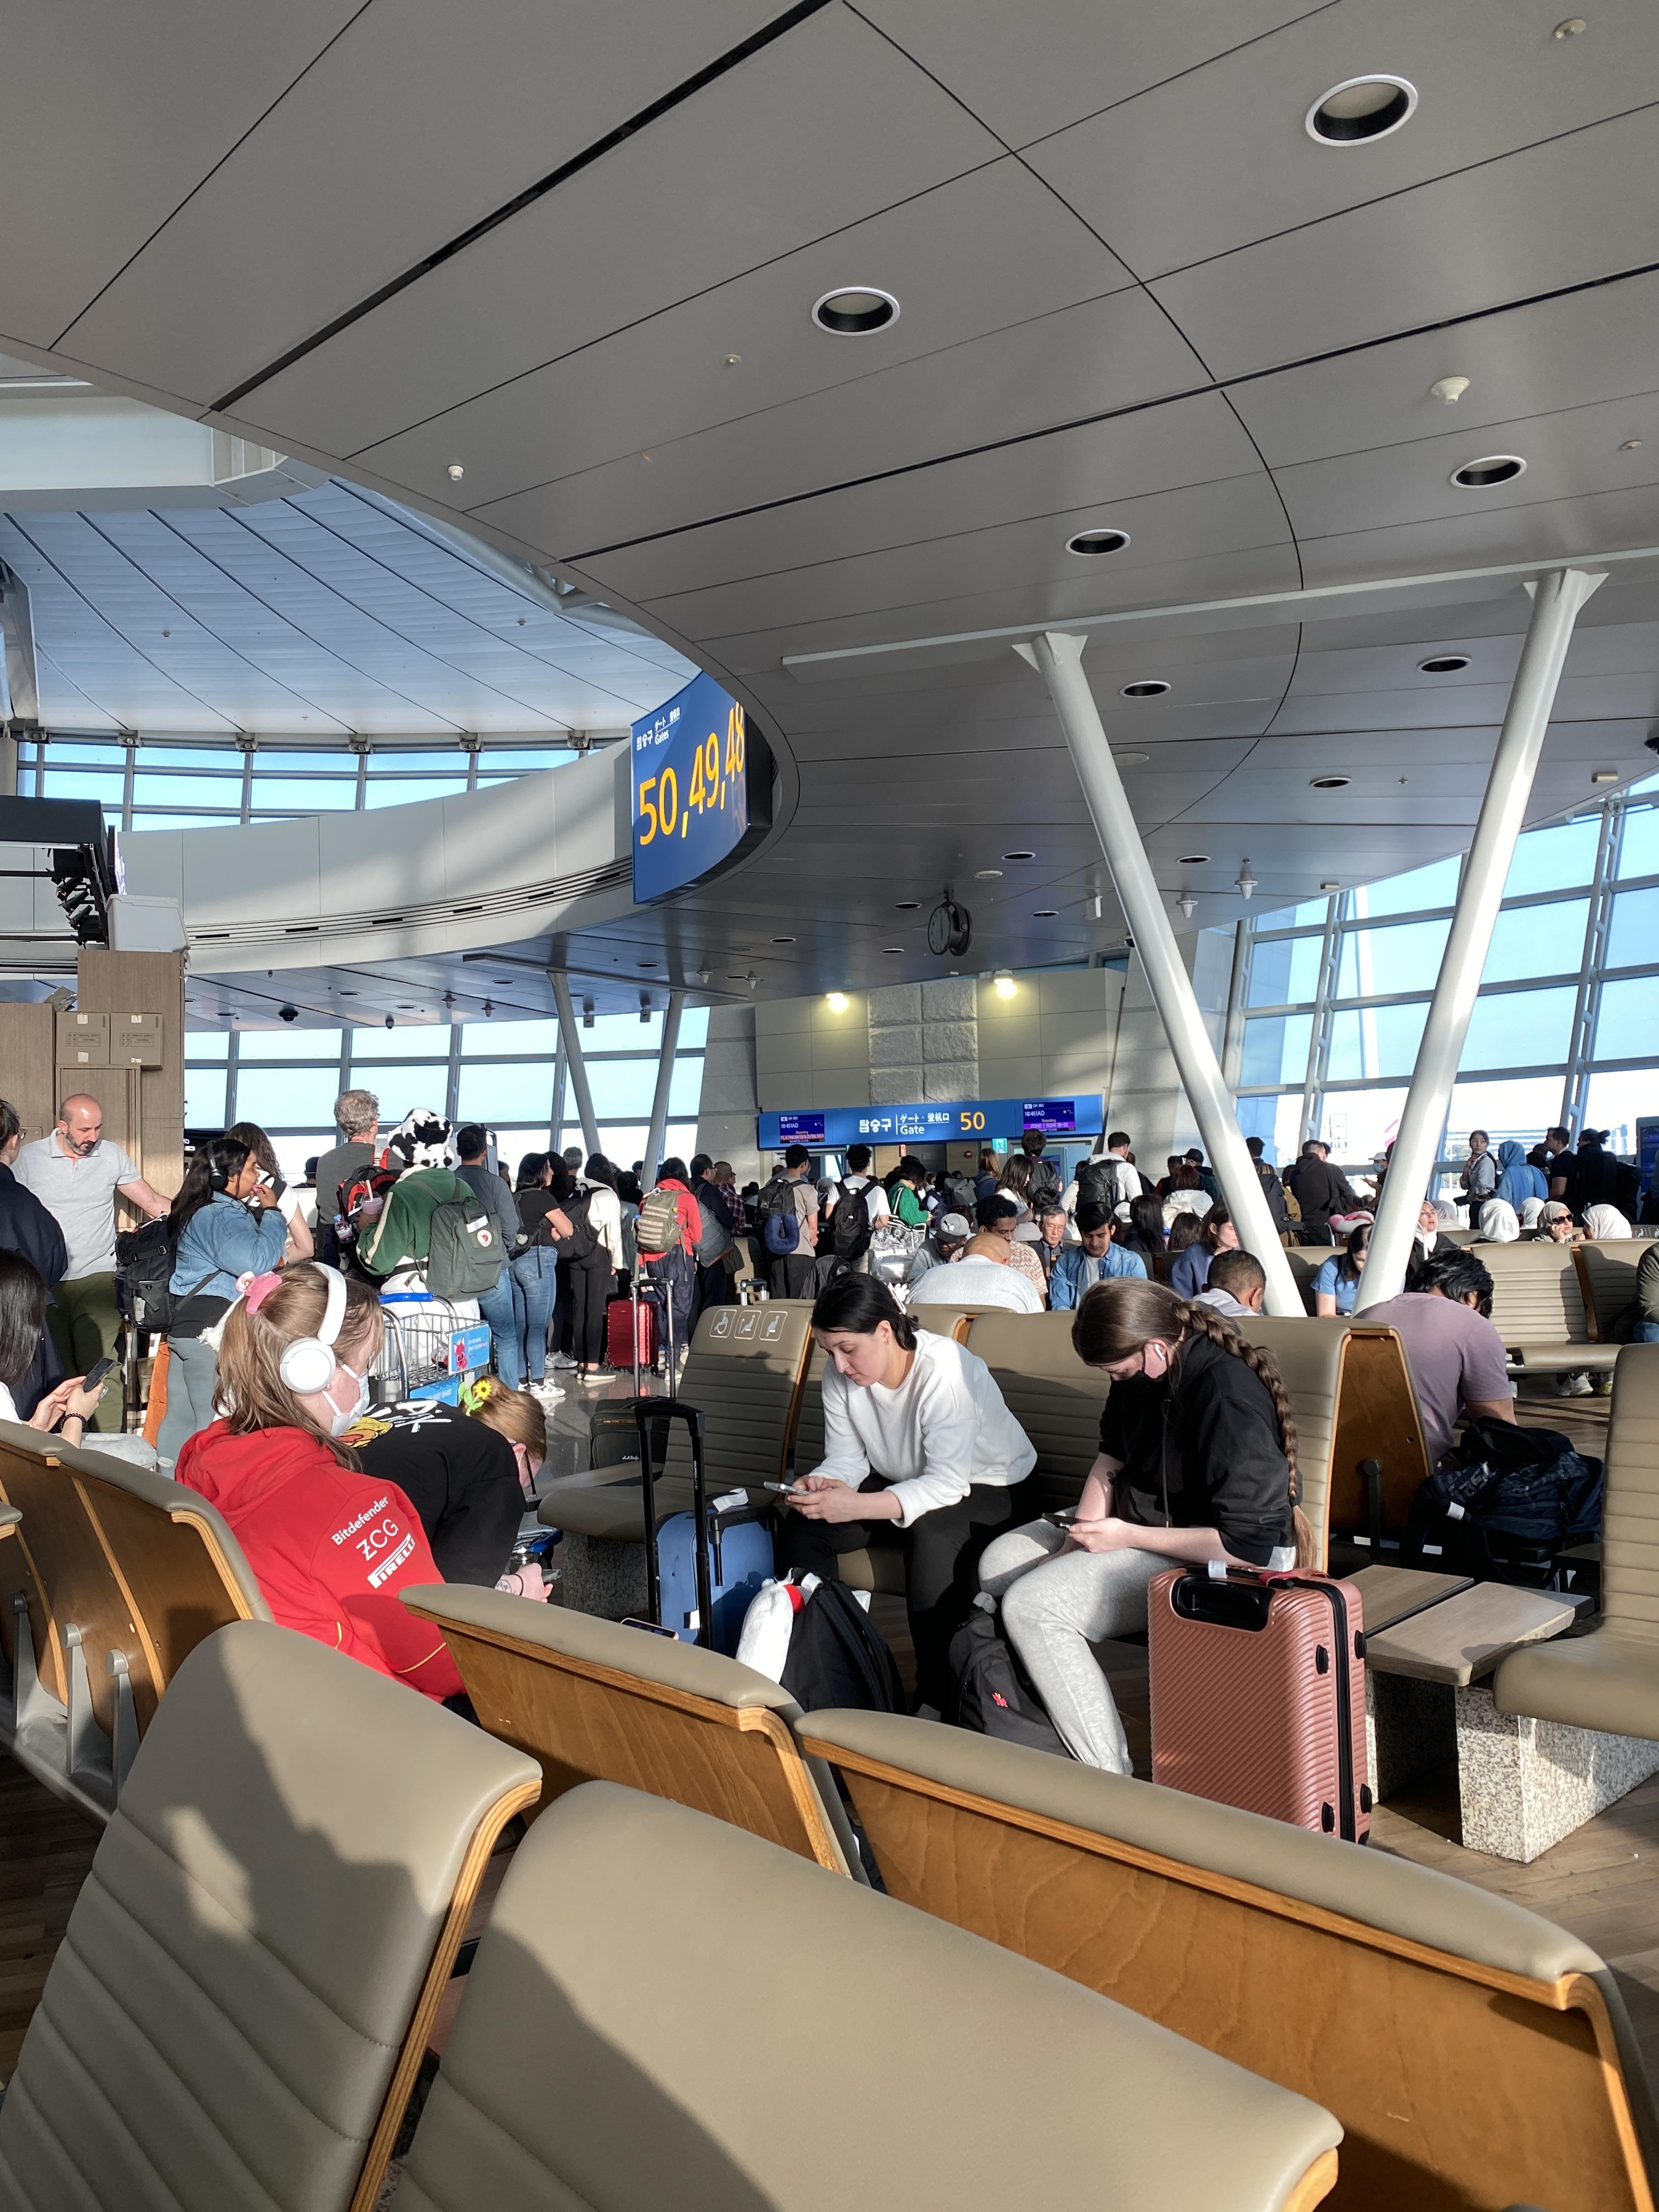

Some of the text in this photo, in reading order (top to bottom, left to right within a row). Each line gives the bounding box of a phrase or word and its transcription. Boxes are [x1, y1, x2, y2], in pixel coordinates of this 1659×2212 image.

[636, 729, 653, 751] 탑승구
[654, 729, 669, 745] Gates
[859, 1119, 891, 1133] 탑승구
[900, 1125, 925, 1135] Gate
[961, 1111, 985, 1131] 50
[331, 1496, 389, 1545] Bitdefender
[366, 1532, 416, 1589] PIRELLI
